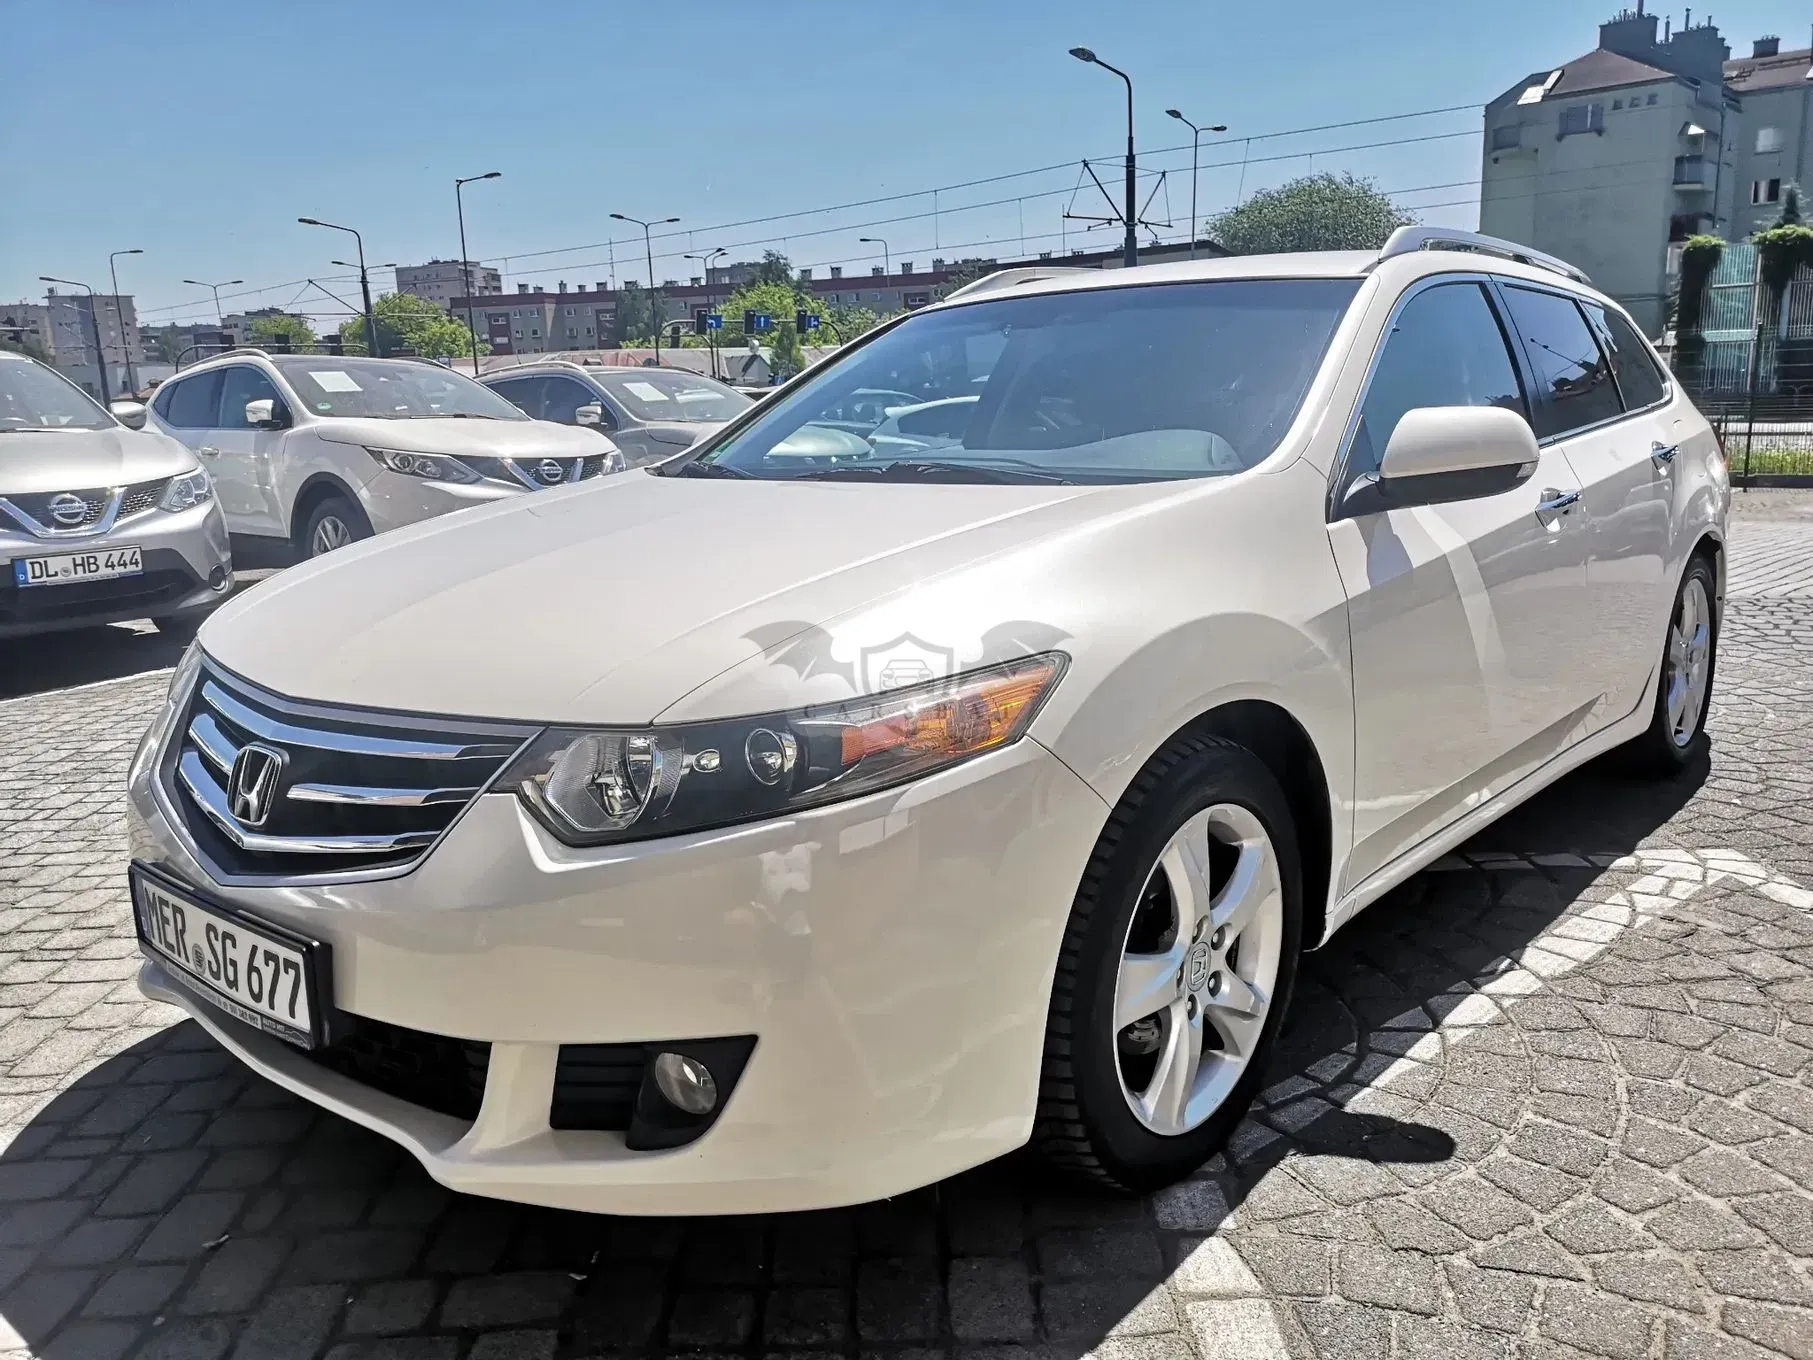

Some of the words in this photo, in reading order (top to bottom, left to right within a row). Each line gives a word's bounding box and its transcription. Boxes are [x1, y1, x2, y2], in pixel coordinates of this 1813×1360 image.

[29, 560, 58, 579] DL
[72, 555, 100, 575] HB
[104, 550, 140, 570] 444
[144, 887, 190, 963] MER
[205, 922, 239, 993] SG
[247, 944, 301, 1020] 677
